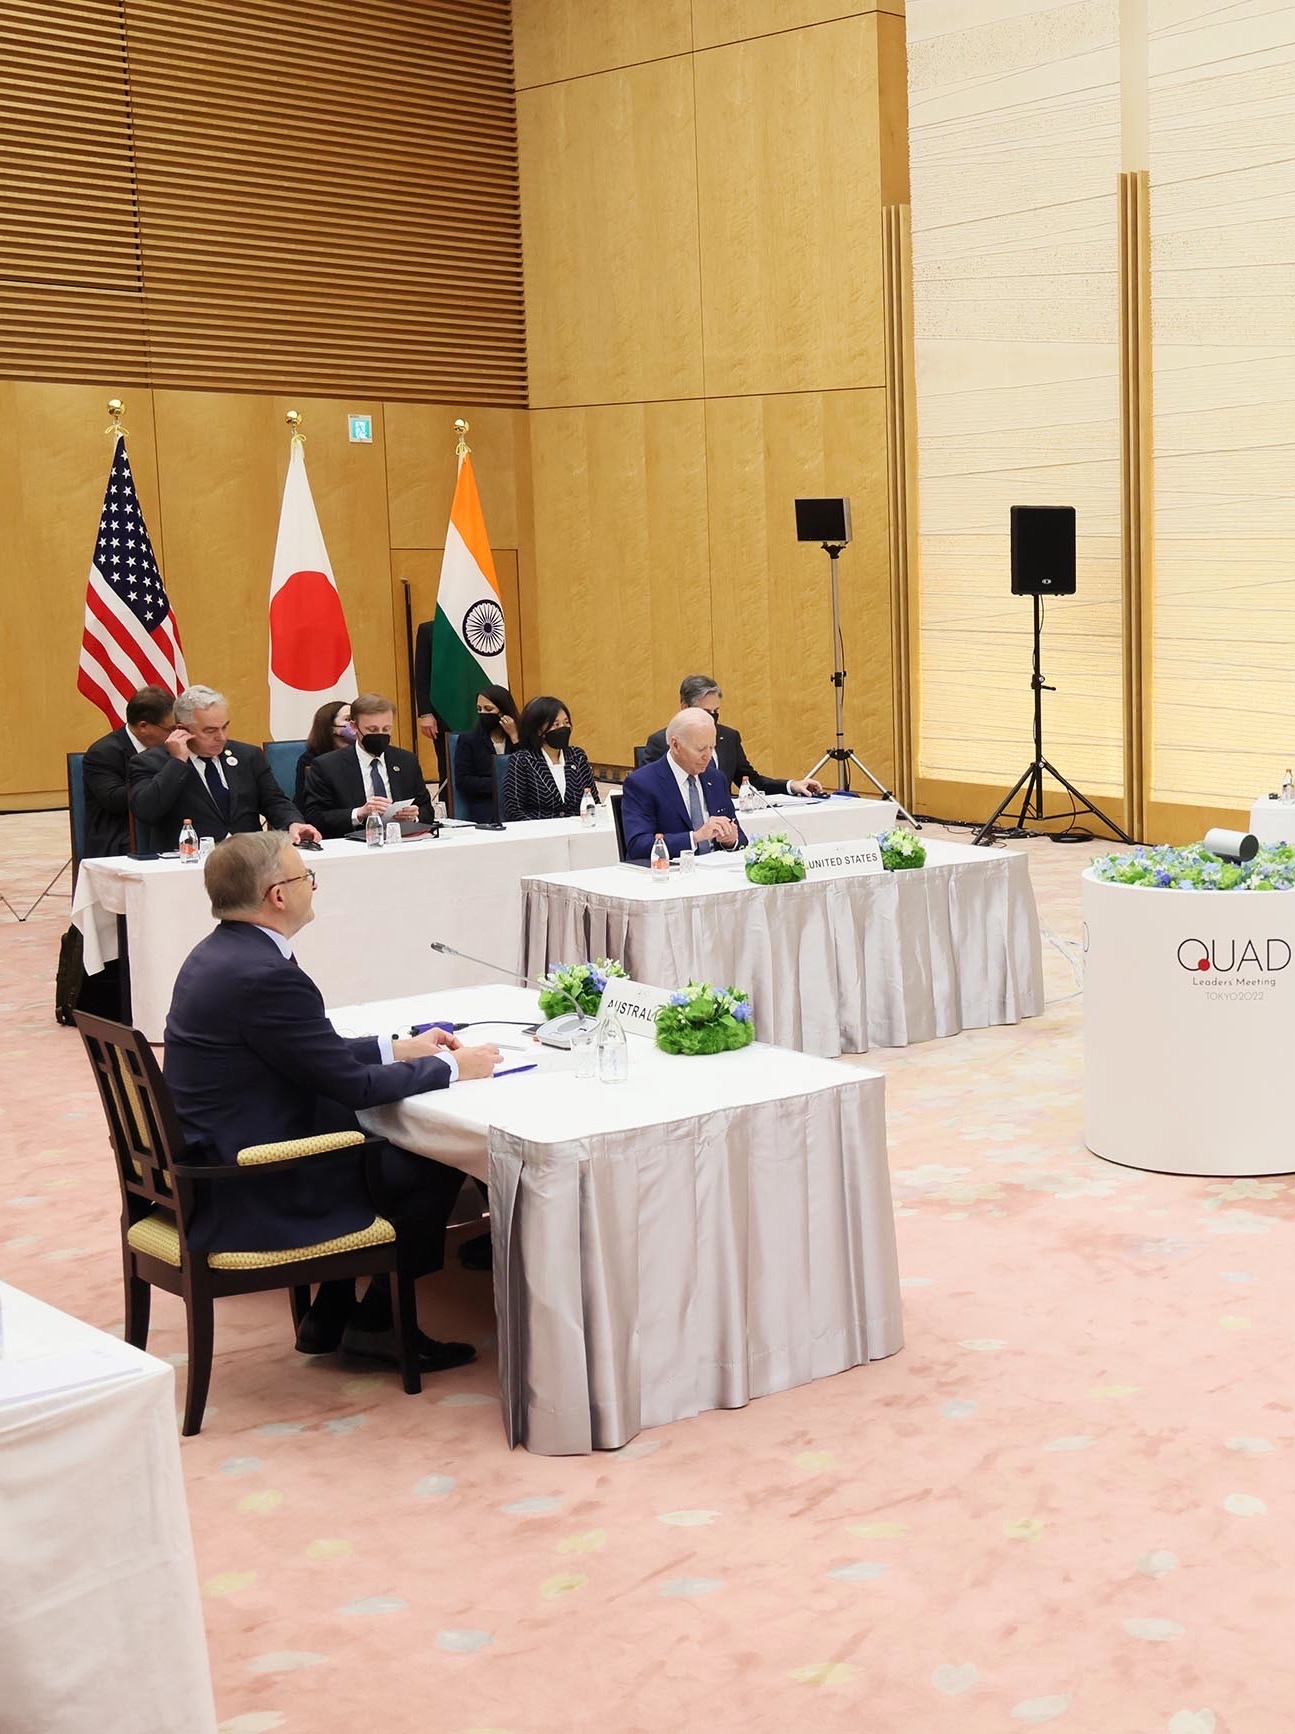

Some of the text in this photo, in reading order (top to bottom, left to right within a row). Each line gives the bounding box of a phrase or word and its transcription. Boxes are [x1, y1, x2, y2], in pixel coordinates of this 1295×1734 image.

[808, 853, 878, 869] UNITED STATES
[1177, 938, 1291, 972] QUAD
[1236, 978, 1276, 987] Meeting
